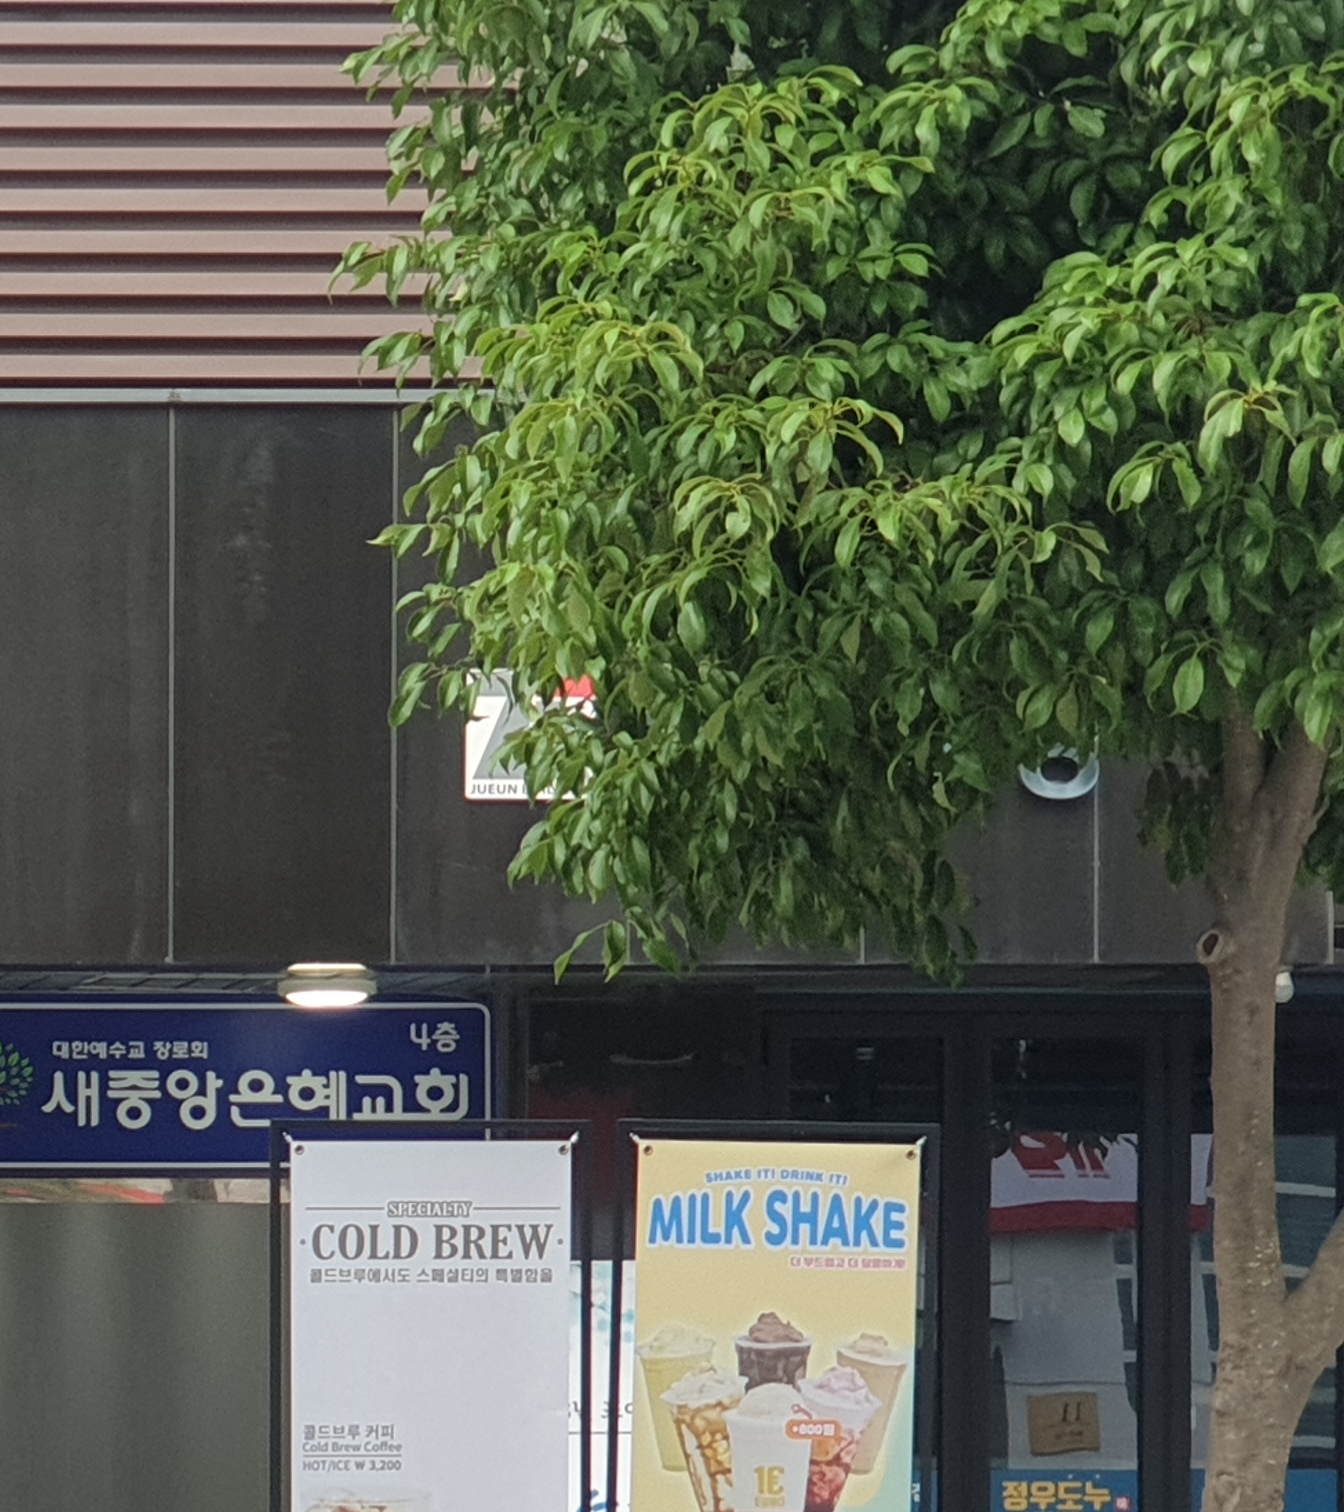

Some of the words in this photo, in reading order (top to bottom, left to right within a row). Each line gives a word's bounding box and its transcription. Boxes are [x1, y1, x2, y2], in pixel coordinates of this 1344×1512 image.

[470, 783, 518, 795] JUEUN
[410, 1021, 461, 1054] 4층
[52, 1041, 146, 1060] 대한예수교
[153, 1041, 210, 1060] 장로회
[41, 1066, 470, 1131] 새중앙은혜교회
[705, 1169, 752, 1184] SHAKE
[387, 1201, 473, 1218] SPECIALTY
[648, 1189, 752, 1245] MILK
[764, 1189, 907, 1249] SHAKE
[312, 1223, 419, 1261] COLD
[432, 1223, 555, 1261] BREW
[303, 1424, 360, 1440] 콜드브루
[365, 1424, 395, 1440] 커피
[302, 1441, 329, 1453] Cold
[331, 1441, 362, 1453] Brew
[363, 1441, 403, 1453] Coffee
